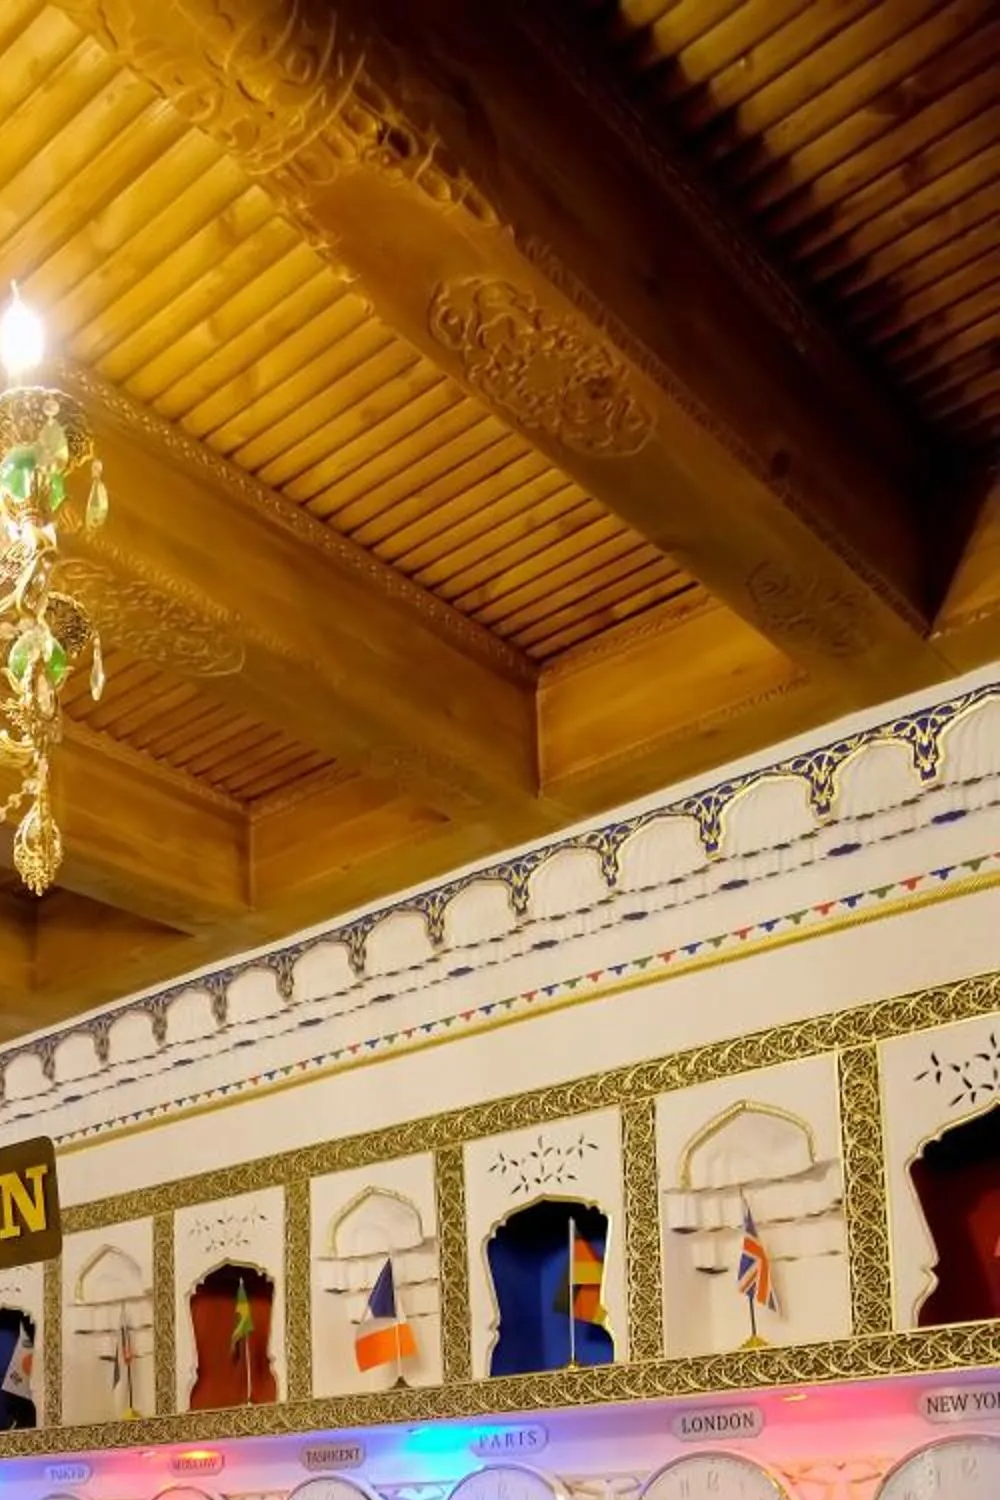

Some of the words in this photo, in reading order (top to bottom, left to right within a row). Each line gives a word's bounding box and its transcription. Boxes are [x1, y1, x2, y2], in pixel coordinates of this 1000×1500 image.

[926, 1393, 970, 1415] NEW
[681, 1412, 755, 1434] LONDON
[479, 1430, 538, 1449] PARIS
[306, 1447, 361, 1465] TASHKENT
